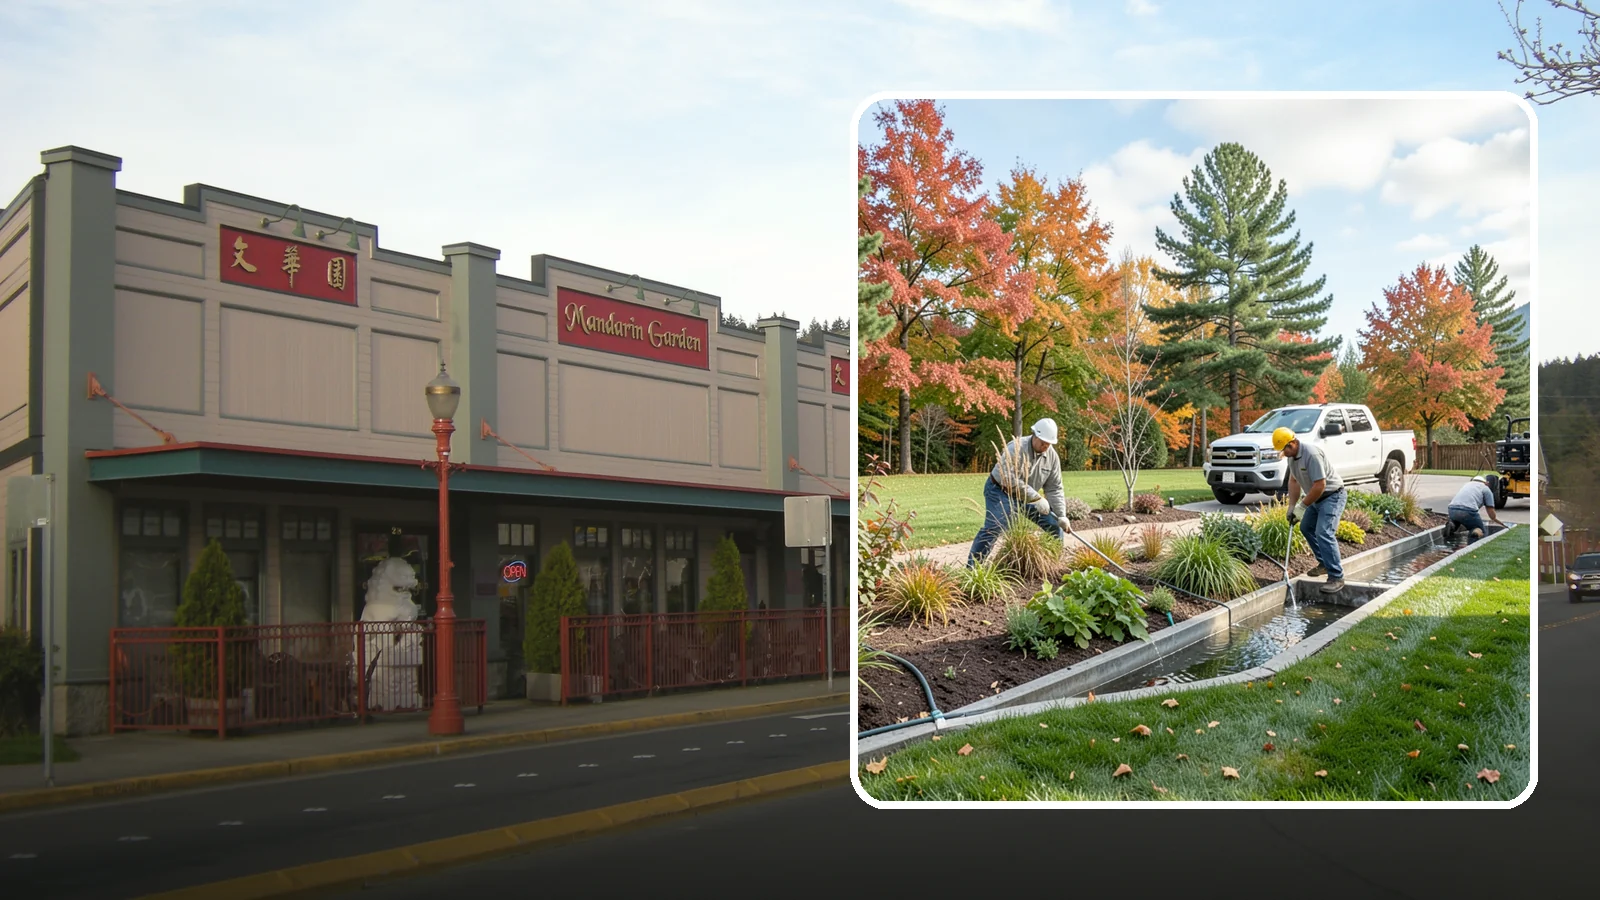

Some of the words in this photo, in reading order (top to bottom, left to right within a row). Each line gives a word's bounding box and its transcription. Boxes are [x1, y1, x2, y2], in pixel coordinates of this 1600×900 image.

[231, 236, 346, 290] 文華園
[564, 302, 644, 341] Mandarin
[648, 320, 701, 352] Garden
[835, 363, 846, 386] 文
[503, 565, 527, 578] OPEN
